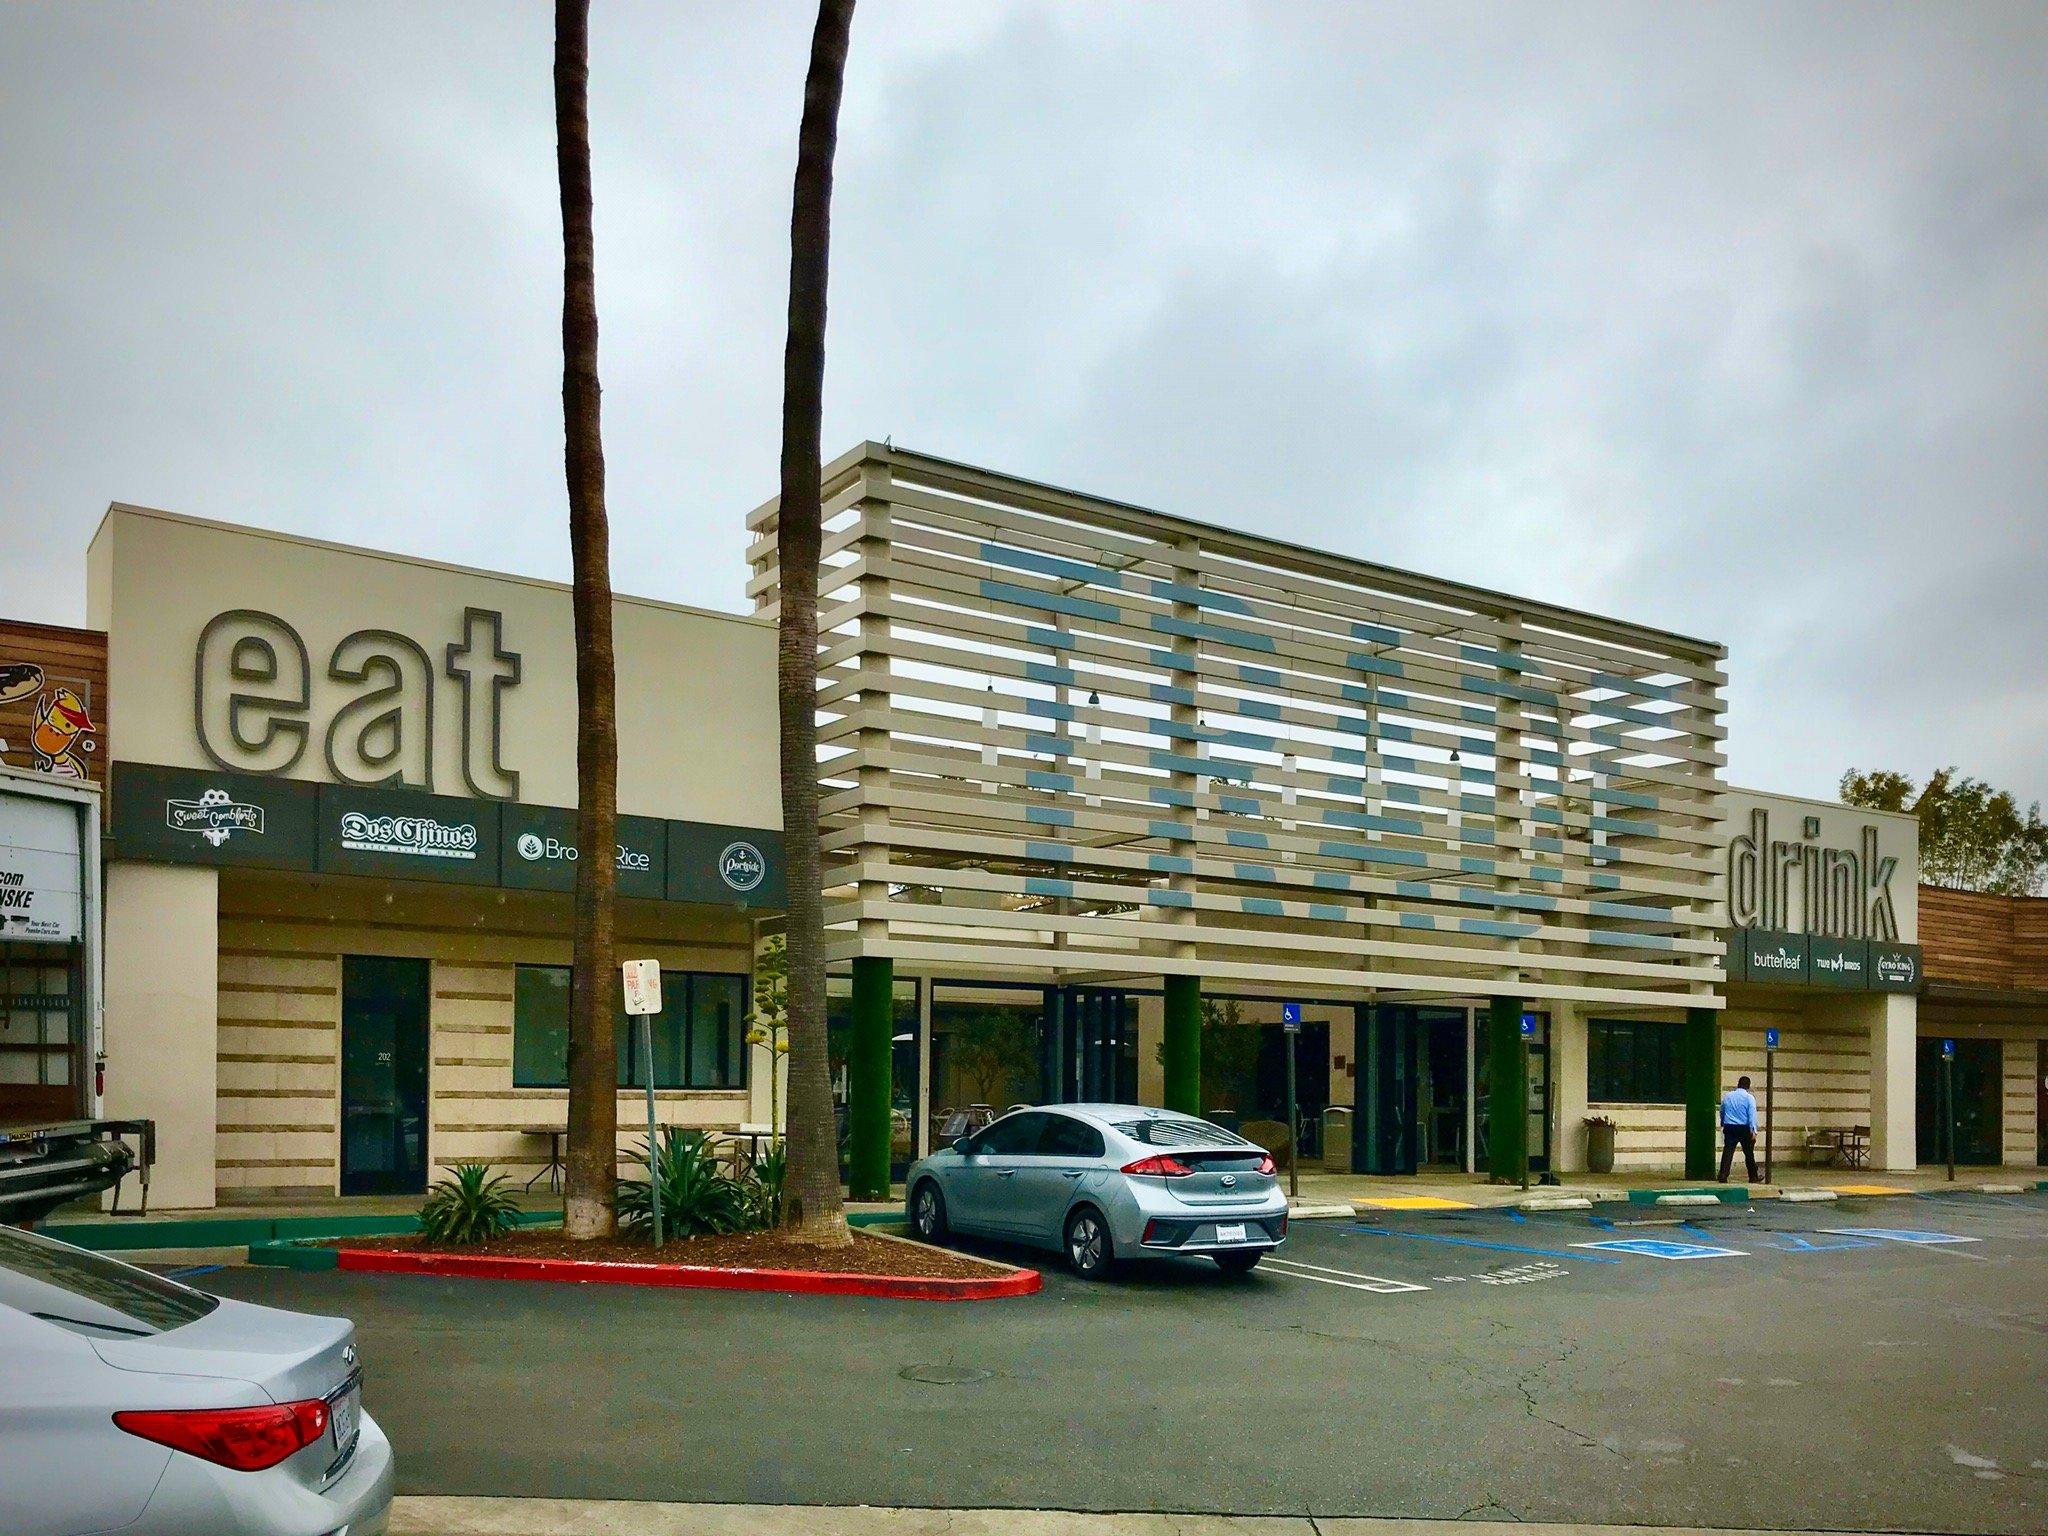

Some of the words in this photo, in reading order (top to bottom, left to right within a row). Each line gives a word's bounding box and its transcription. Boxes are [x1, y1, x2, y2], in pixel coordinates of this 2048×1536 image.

[195, 606, 521, 801] eat
[174, 808, 209, 826] Sweet
[342, 812, 394, 842] Dos
[393, 817, 477, 849] Chinos
[546, 838, 579, 861] Bro
[615, 844, 649, 866] Rice
[1728, 808, 1899, 942] drink
[1754, 948, 1801, 969] butterleaf
[1844, 961, 1860, 971] BIRDS
[1897, 962, 1911, 972] KING
[378, 1051, 391, 1061] 202
